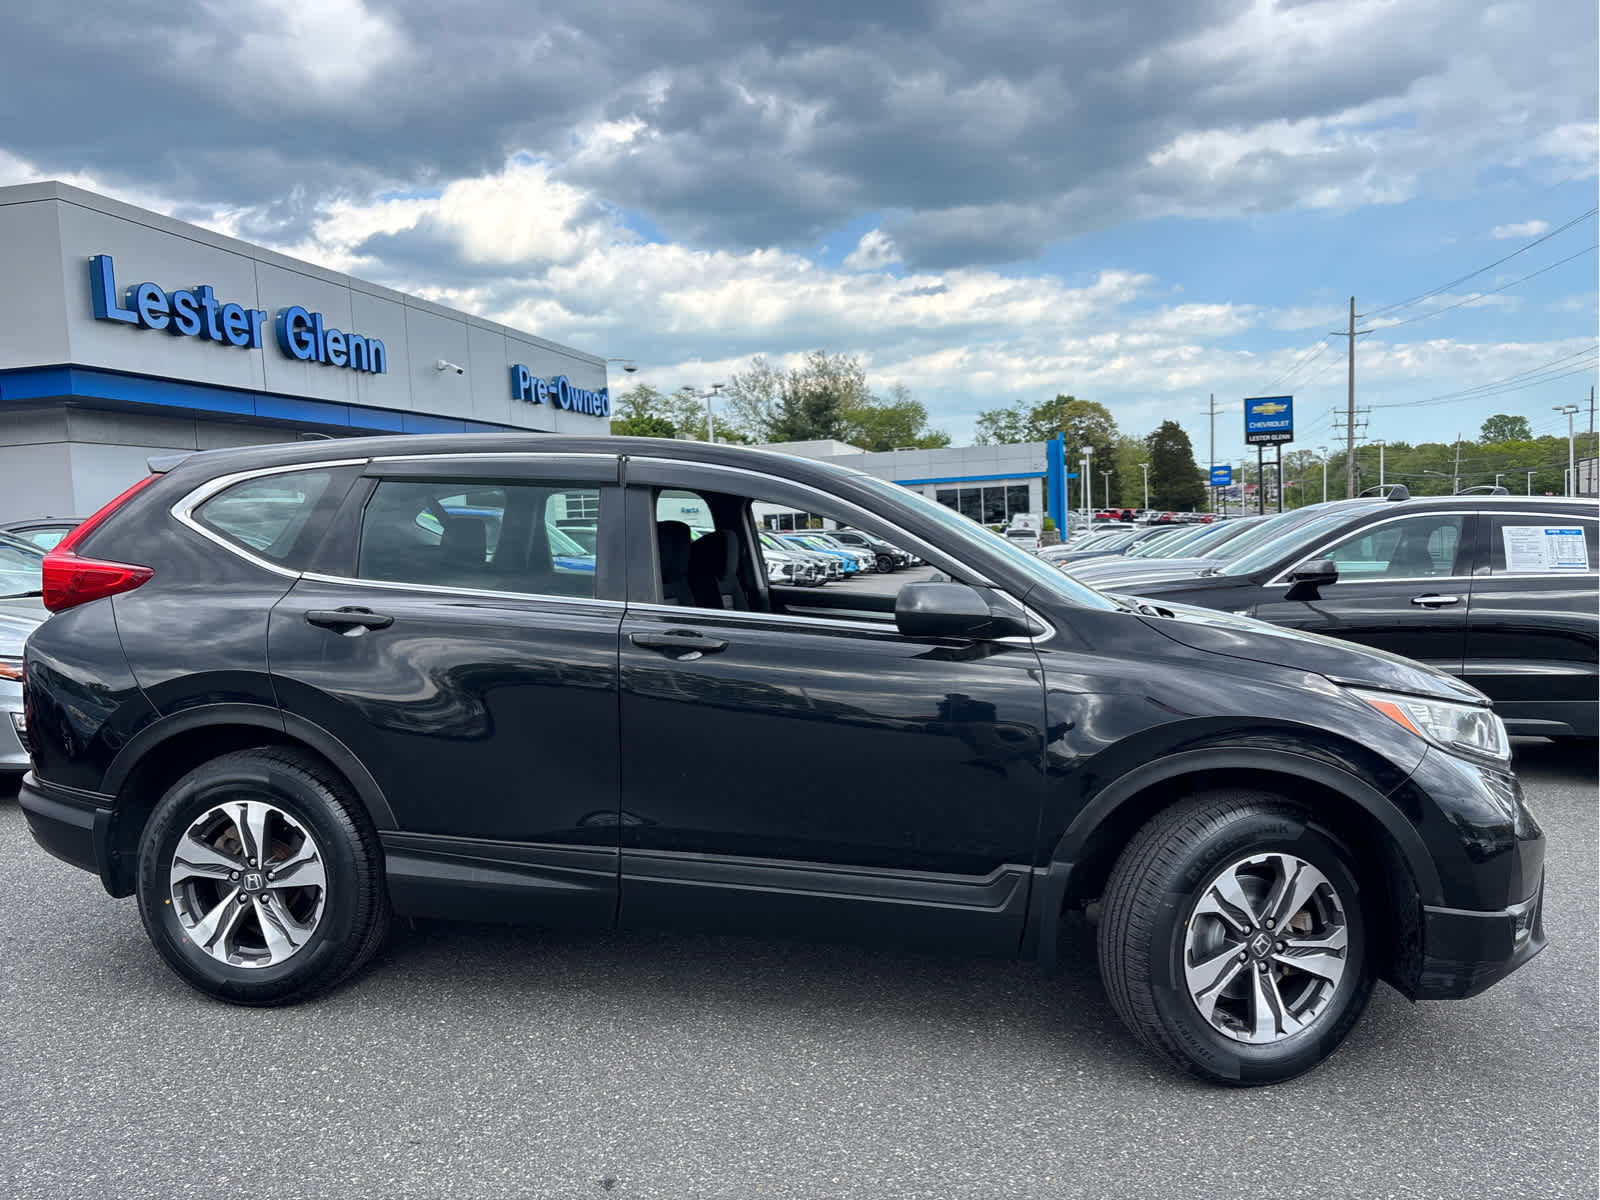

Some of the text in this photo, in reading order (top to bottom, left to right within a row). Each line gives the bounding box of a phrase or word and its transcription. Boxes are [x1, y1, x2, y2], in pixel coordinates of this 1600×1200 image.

[90, 254, 387, 375] Lester Glenn
[512, 364, 610, 417] Pre-Owned
[1249, 420, 1289, 429] CHEVROLET
